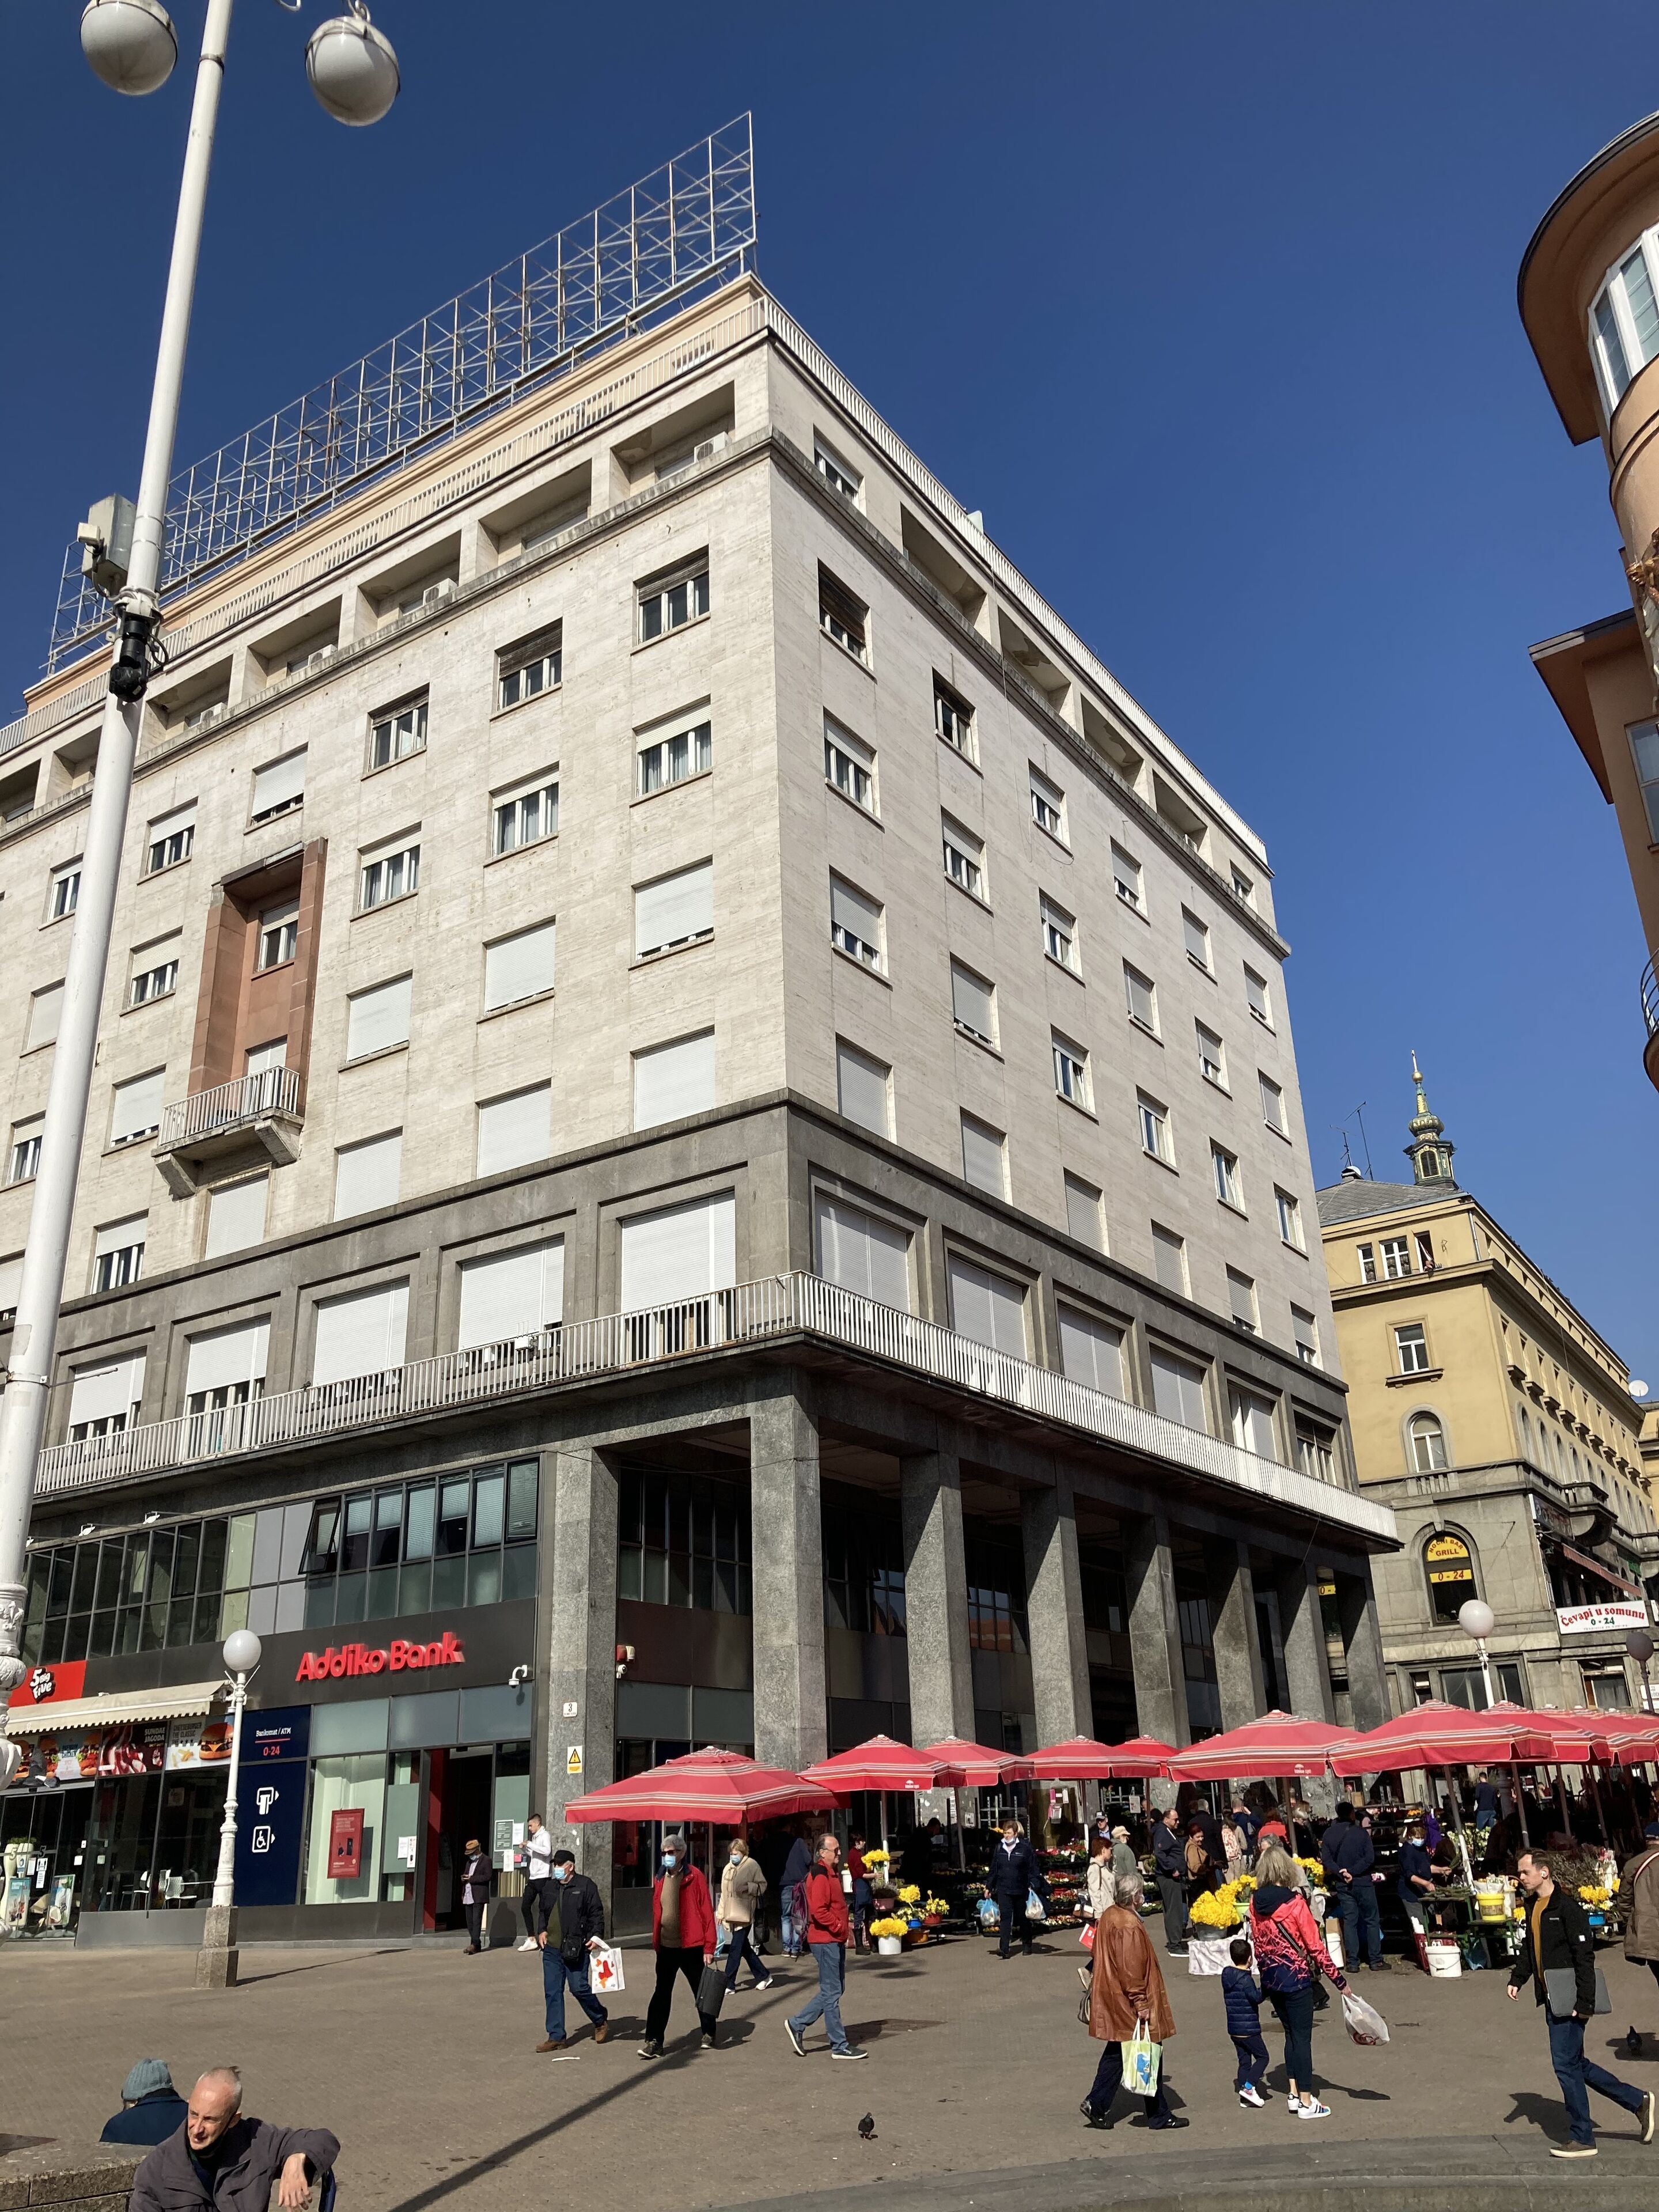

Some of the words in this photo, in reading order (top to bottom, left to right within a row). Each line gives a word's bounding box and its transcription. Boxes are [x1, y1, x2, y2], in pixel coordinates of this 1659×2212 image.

[1450, 1539, 1463, 1550] BAR
[1435, 1548, 1460, 1556] GRILL
[1438, 1572, 1443, 1581] 0
[1453, 1571, 1464, 1579] 24
[1560, 1608, 1594, 1627] Čevapi
[1594, 1608, 1603, 1616] u
[1604, 1607, 1645, 1620] somunu
[1603, 1616, 1615, 1625] 24
[295, 1643, 388, 1682] Addiko
[389, 1632, 465, 1671] Bank
[568, 1703, 573, 1713] 3
[144, 1727, 166, 1736] SUNDAE
[144, 1734, 165, 1743] JAGODA
